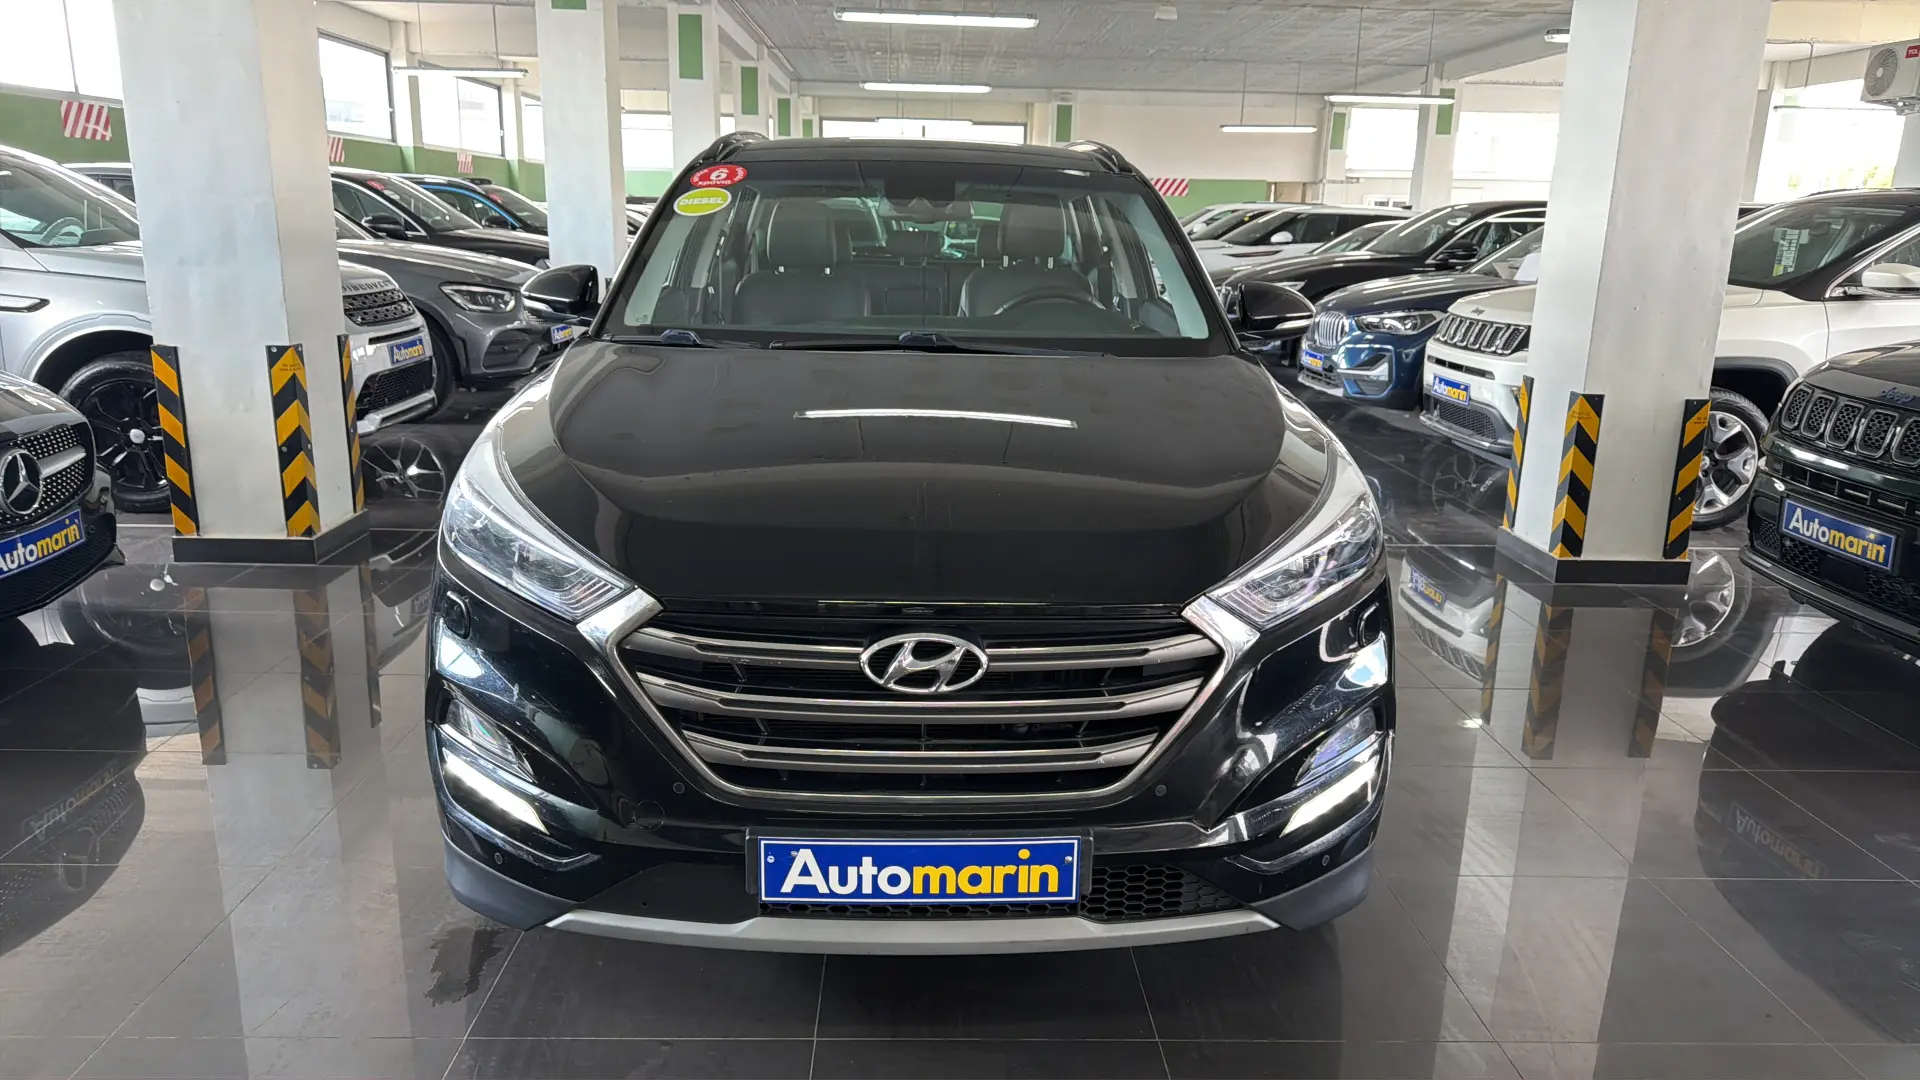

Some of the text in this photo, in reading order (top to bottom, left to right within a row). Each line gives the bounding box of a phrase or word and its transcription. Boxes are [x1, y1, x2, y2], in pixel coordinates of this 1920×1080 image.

[710, 169, 729, 180] 6
[679, 197, 725, 205] DIESEL
[393, 341, 424, 363] Automarin
[1433, 376, 1468, 402] Automarin
[1788, 508, 1886, 563] Automarin
[780, 848, 1059, 894] Automarin
